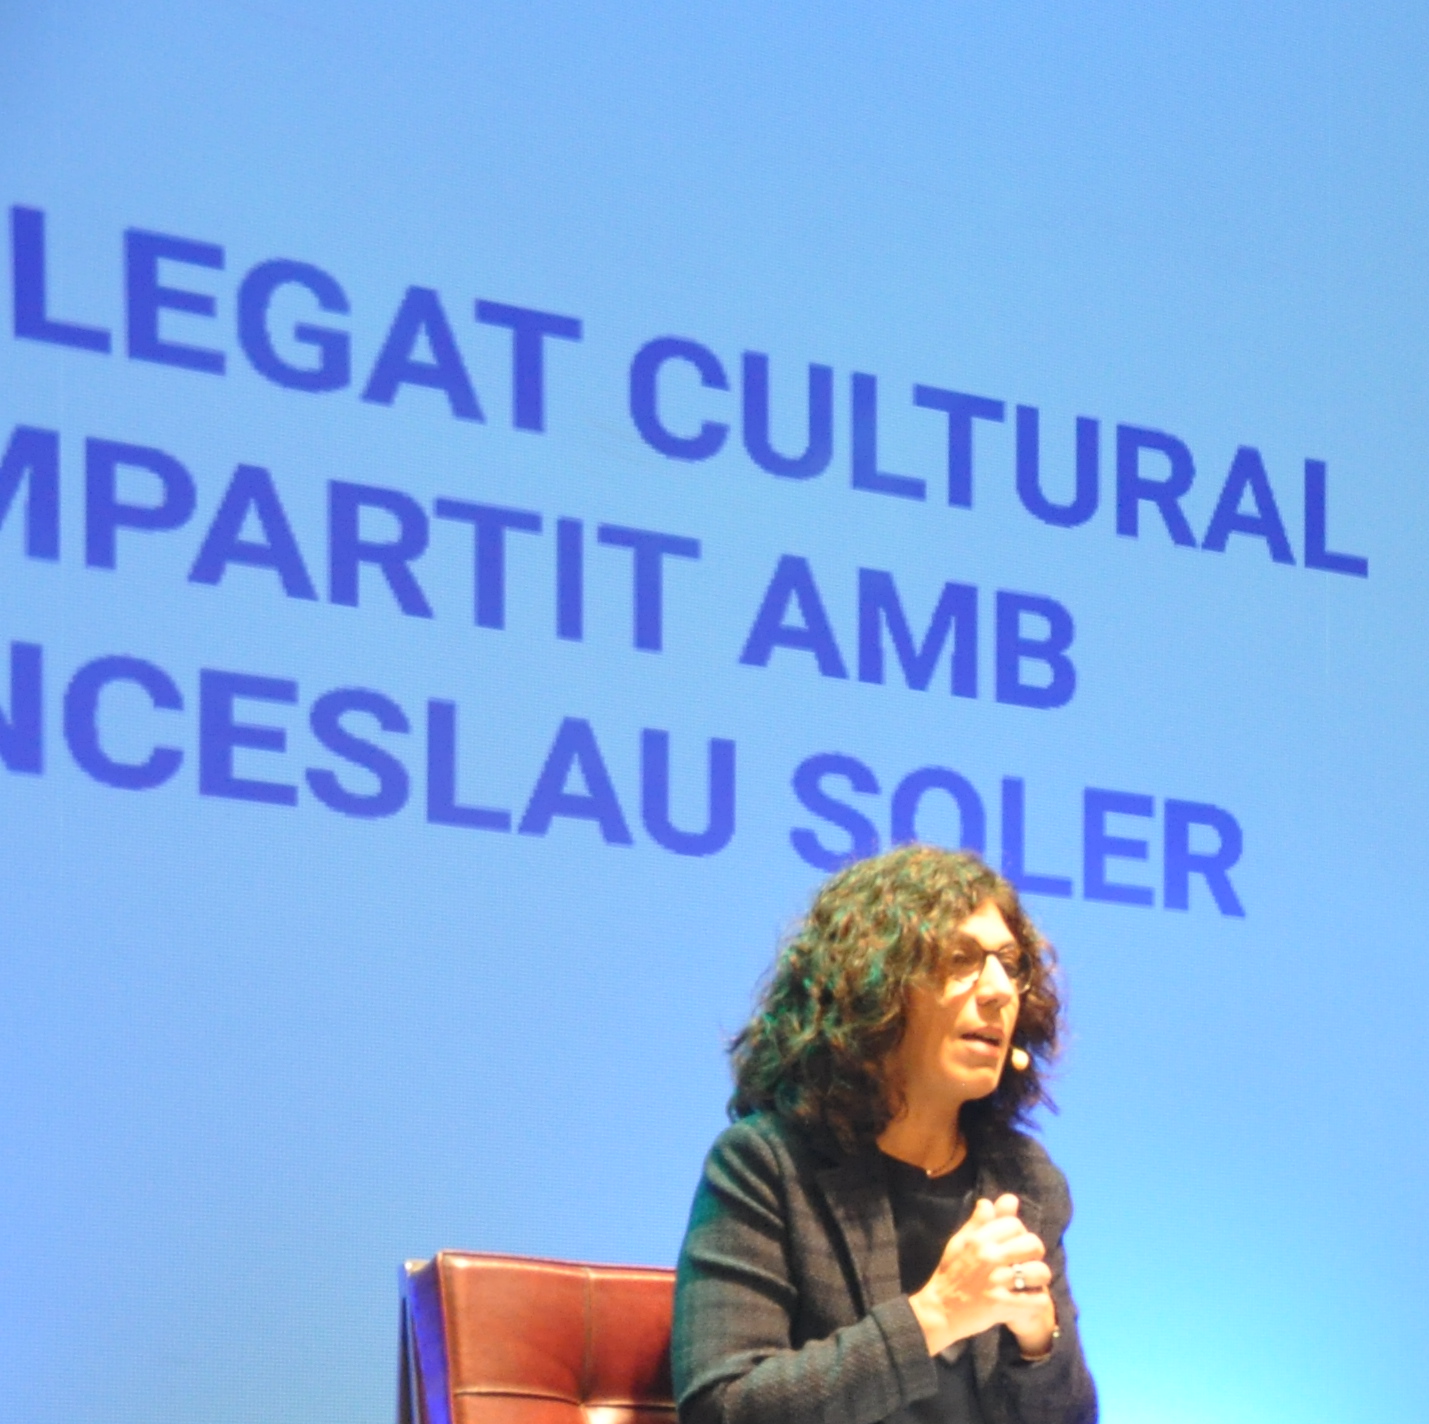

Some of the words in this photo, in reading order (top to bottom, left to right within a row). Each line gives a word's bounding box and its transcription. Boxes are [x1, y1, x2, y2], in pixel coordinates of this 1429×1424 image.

[11, 204, 584, 435] LEGAT
[629, 336, 1370, 578] CULTURAL
[738, 553, 1078, 711] AMB
[788, 750, 1248, 919] SOLER
